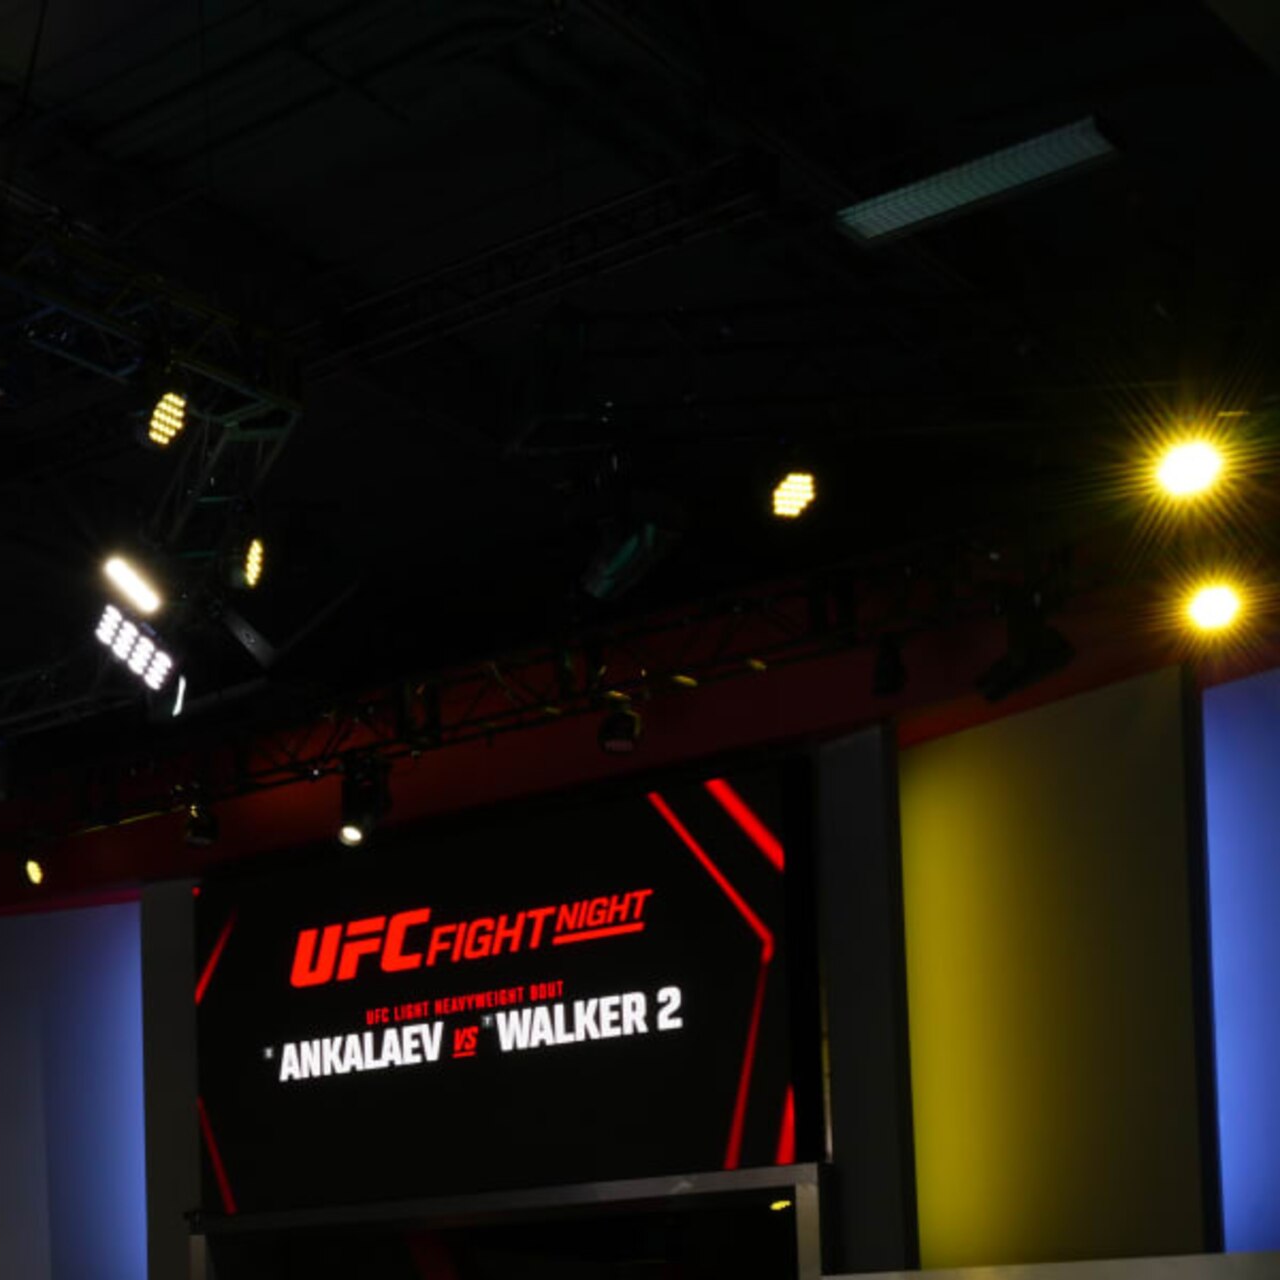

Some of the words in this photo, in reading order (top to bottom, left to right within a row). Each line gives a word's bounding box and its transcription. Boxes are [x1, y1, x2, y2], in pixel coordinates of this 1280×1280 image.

[290, 906, 432, 988] UFC
[425, 905, 558, 967] FIGHT
[555, 888, 654, 934] NIGHT
[279, 1020, 444, 1082] ANKALAEV
[452, 1026, 480, 1053] VS
[495, 990, 648, 1052] WALKER
[656, 986, 683, 1031] 2
[365, 1007, 390, 1025] UFC
[394, 1001, 430, 1021] LIGHT
[434, 986, 525, 1015] HEAVYWEIGHT
